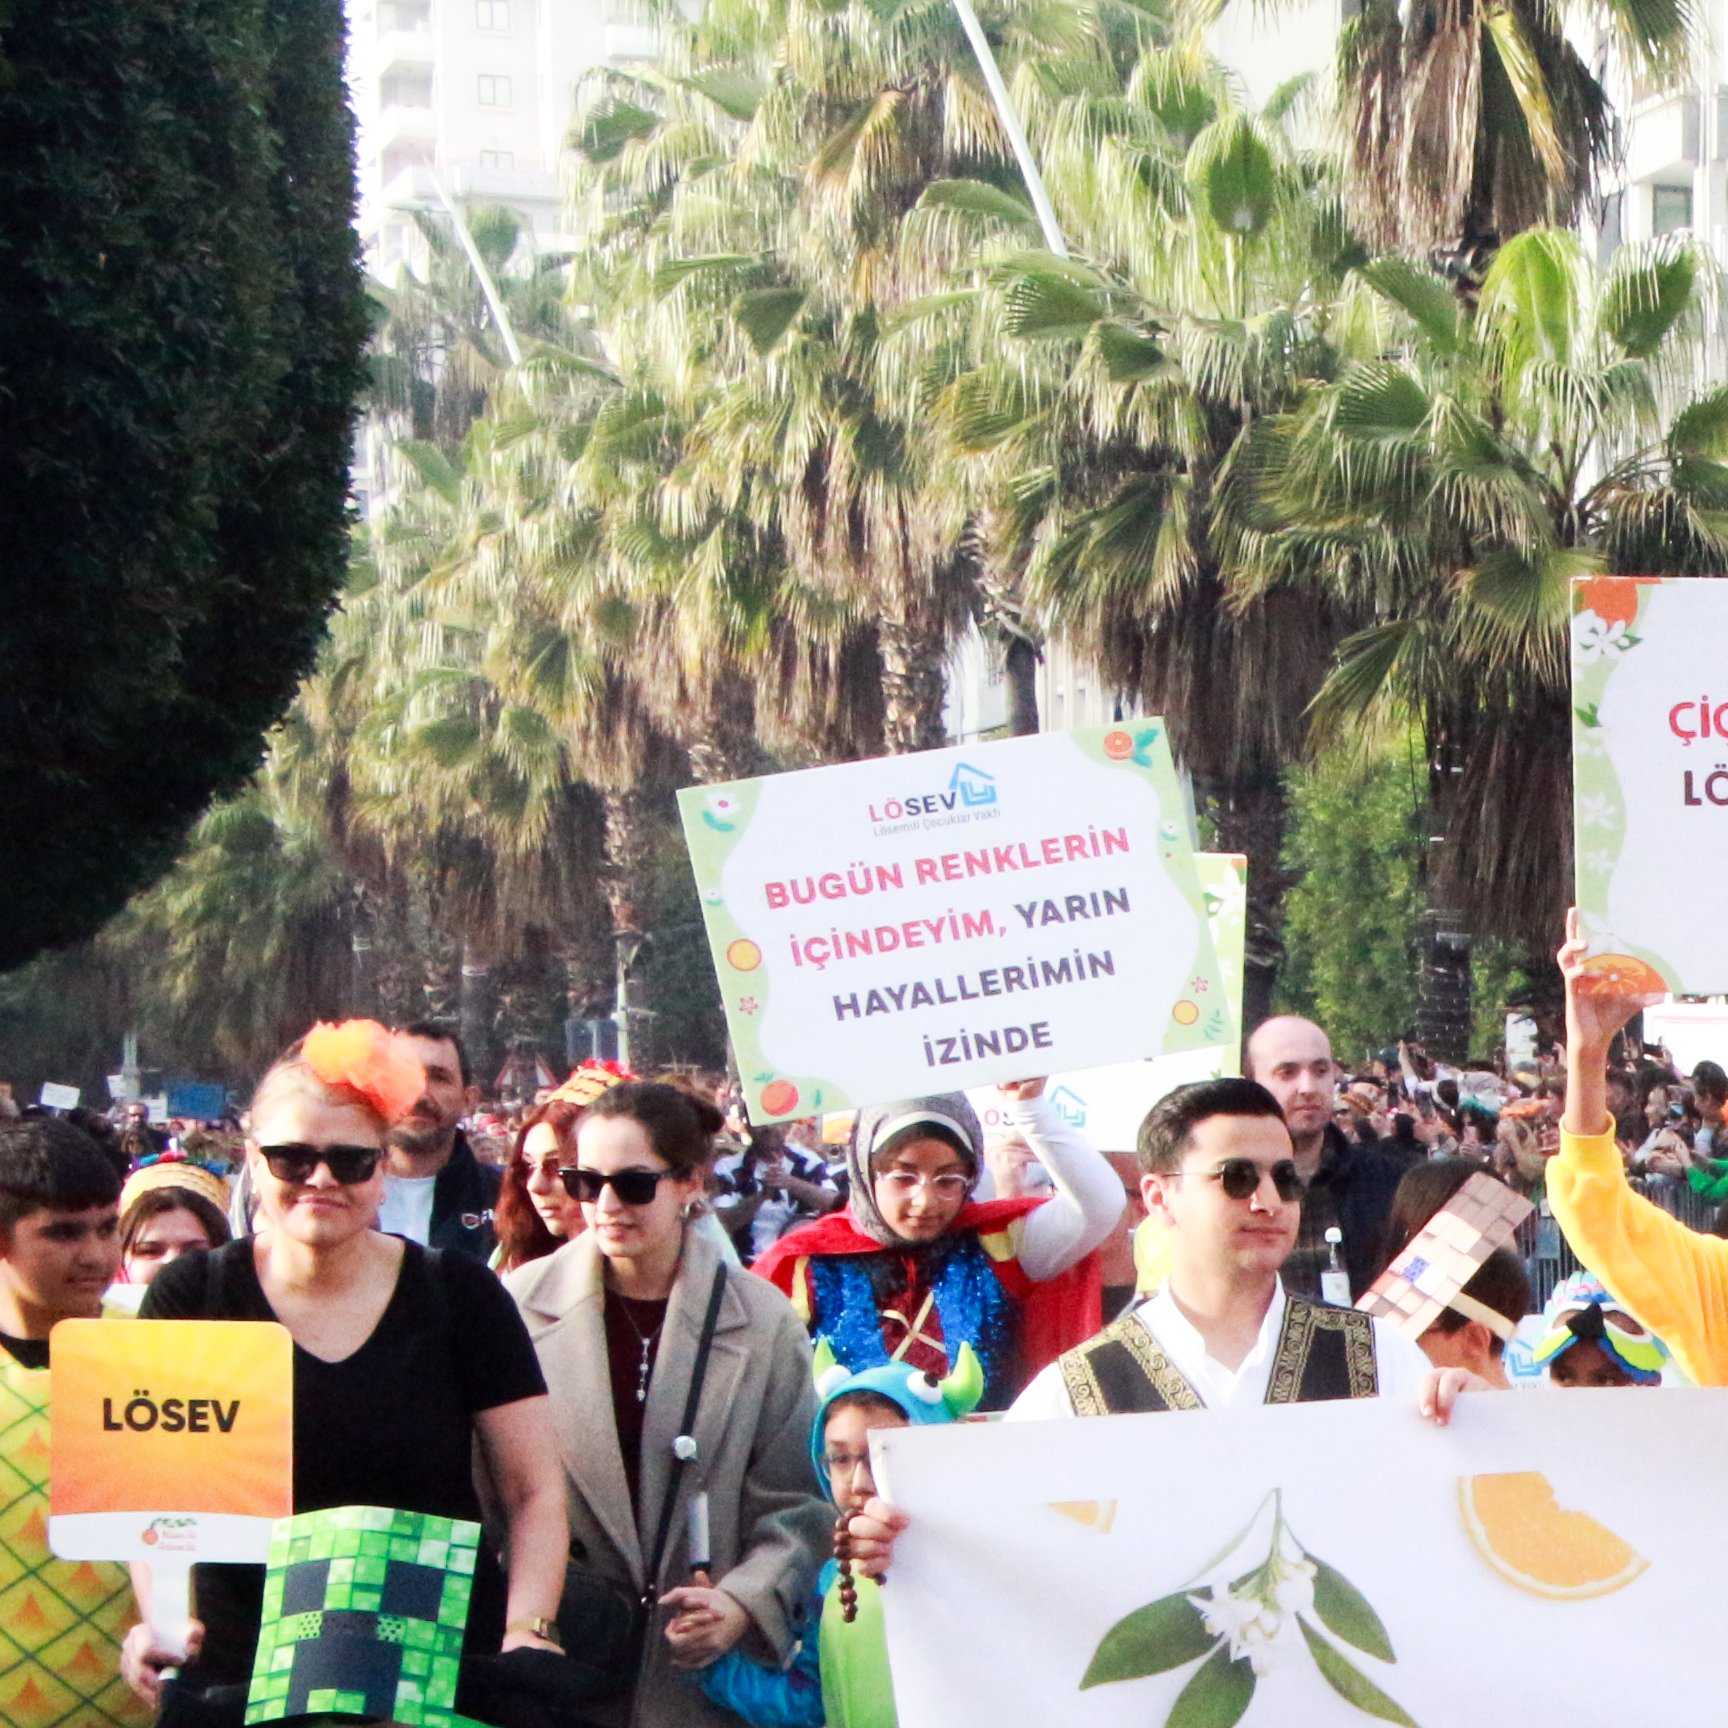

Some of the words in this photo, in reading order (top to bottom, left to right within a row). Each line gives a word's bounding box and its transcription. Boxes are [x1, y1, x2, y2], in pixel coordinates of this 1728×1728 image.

[868, 790, 956, 822] LÖSEV
[764, 860, 902, 910] BUGÜN
[916, 825, 1131, 886] RENKLERİN
[790, 906, 1007, 973] İÇİNDEYİM,
[1014, 887, 1131, 931] YARIN
[832, 946, 1116, 1021] HAYALLERİMİN
[923, 1021, 1054, 1067] İZİNDE
[103, 1389, 241, 1433] LÖSEV
